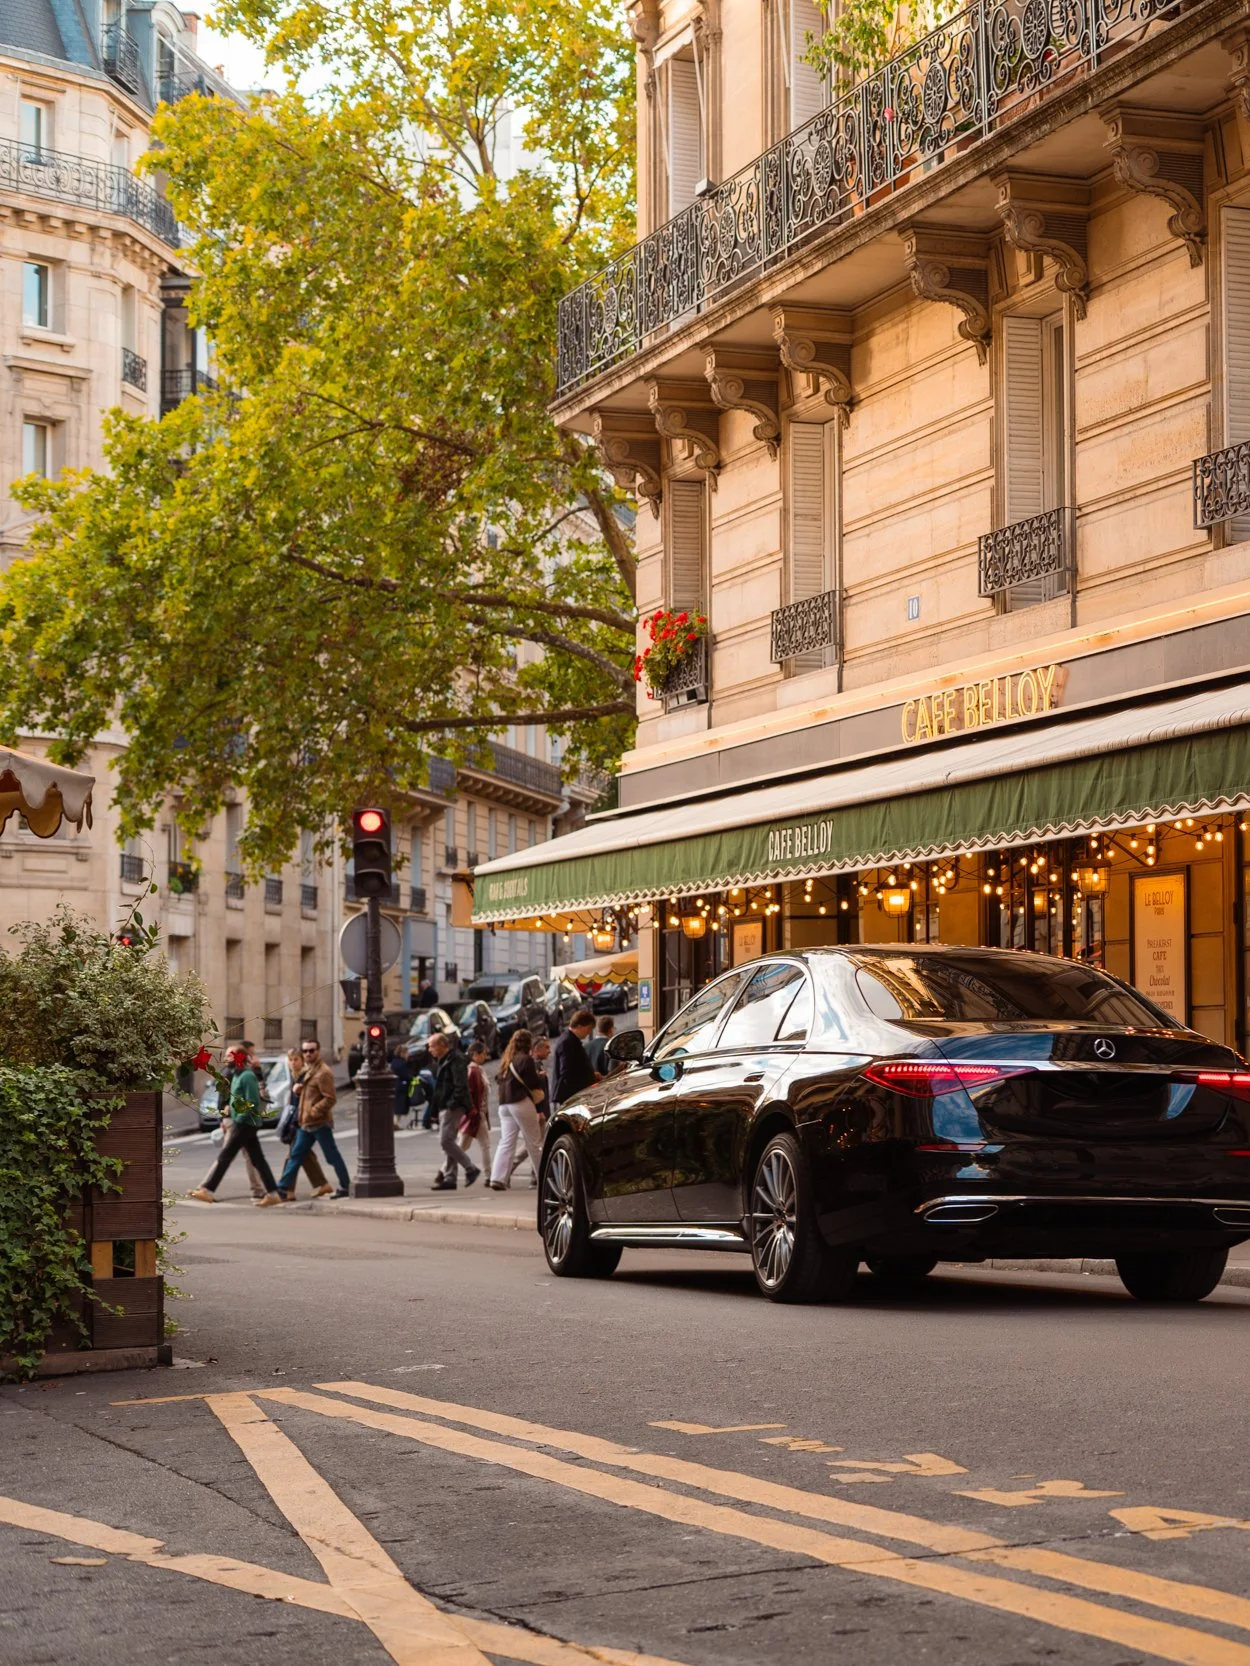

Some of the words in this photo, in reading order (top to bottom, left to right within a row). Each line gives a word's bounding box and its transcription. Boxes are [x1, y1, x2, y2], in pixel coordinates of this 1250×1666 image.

[909, 598, 918, 619] 10
[901, 689, 957, 744] CAFE
[963, 664, 1056, 729] BELLOY
[768, 828, 793, 861] CAFE
[794, 820, 834, 858] BELLOY
[1144, 892, 1151, 907] LE
[1152, 890, 1174, 906] BELLOY
[1149, 974, 1171, 987] Chocolat
